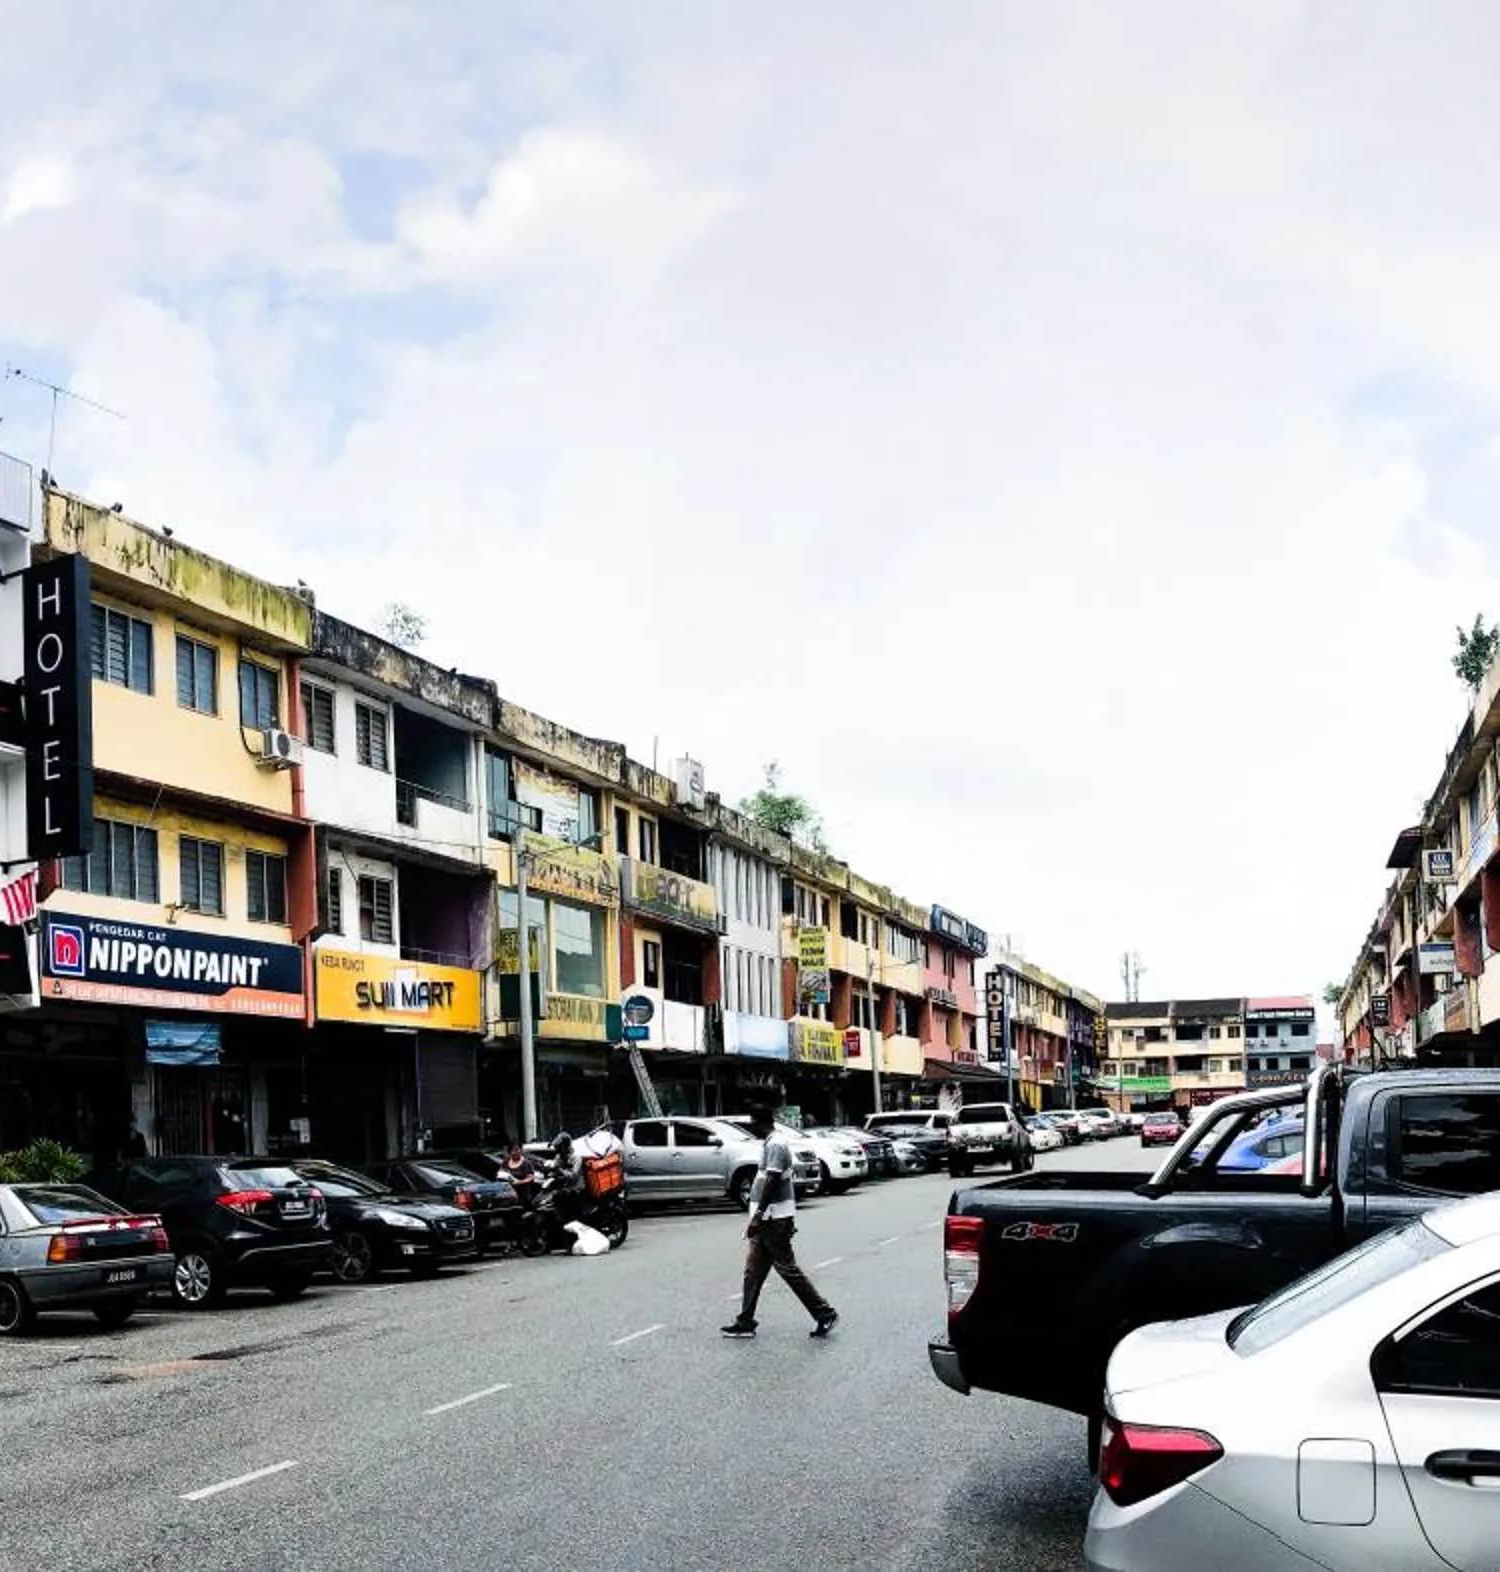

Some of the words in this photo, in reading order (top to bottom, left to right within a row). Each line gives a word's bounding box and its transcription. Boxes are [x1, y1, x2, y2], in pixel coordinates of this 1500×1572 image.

[37, 577, 63, 834] HOTEL
[400, 980, 455, 1009] MART
[988, 974, 1003, 1053] HOTEL
